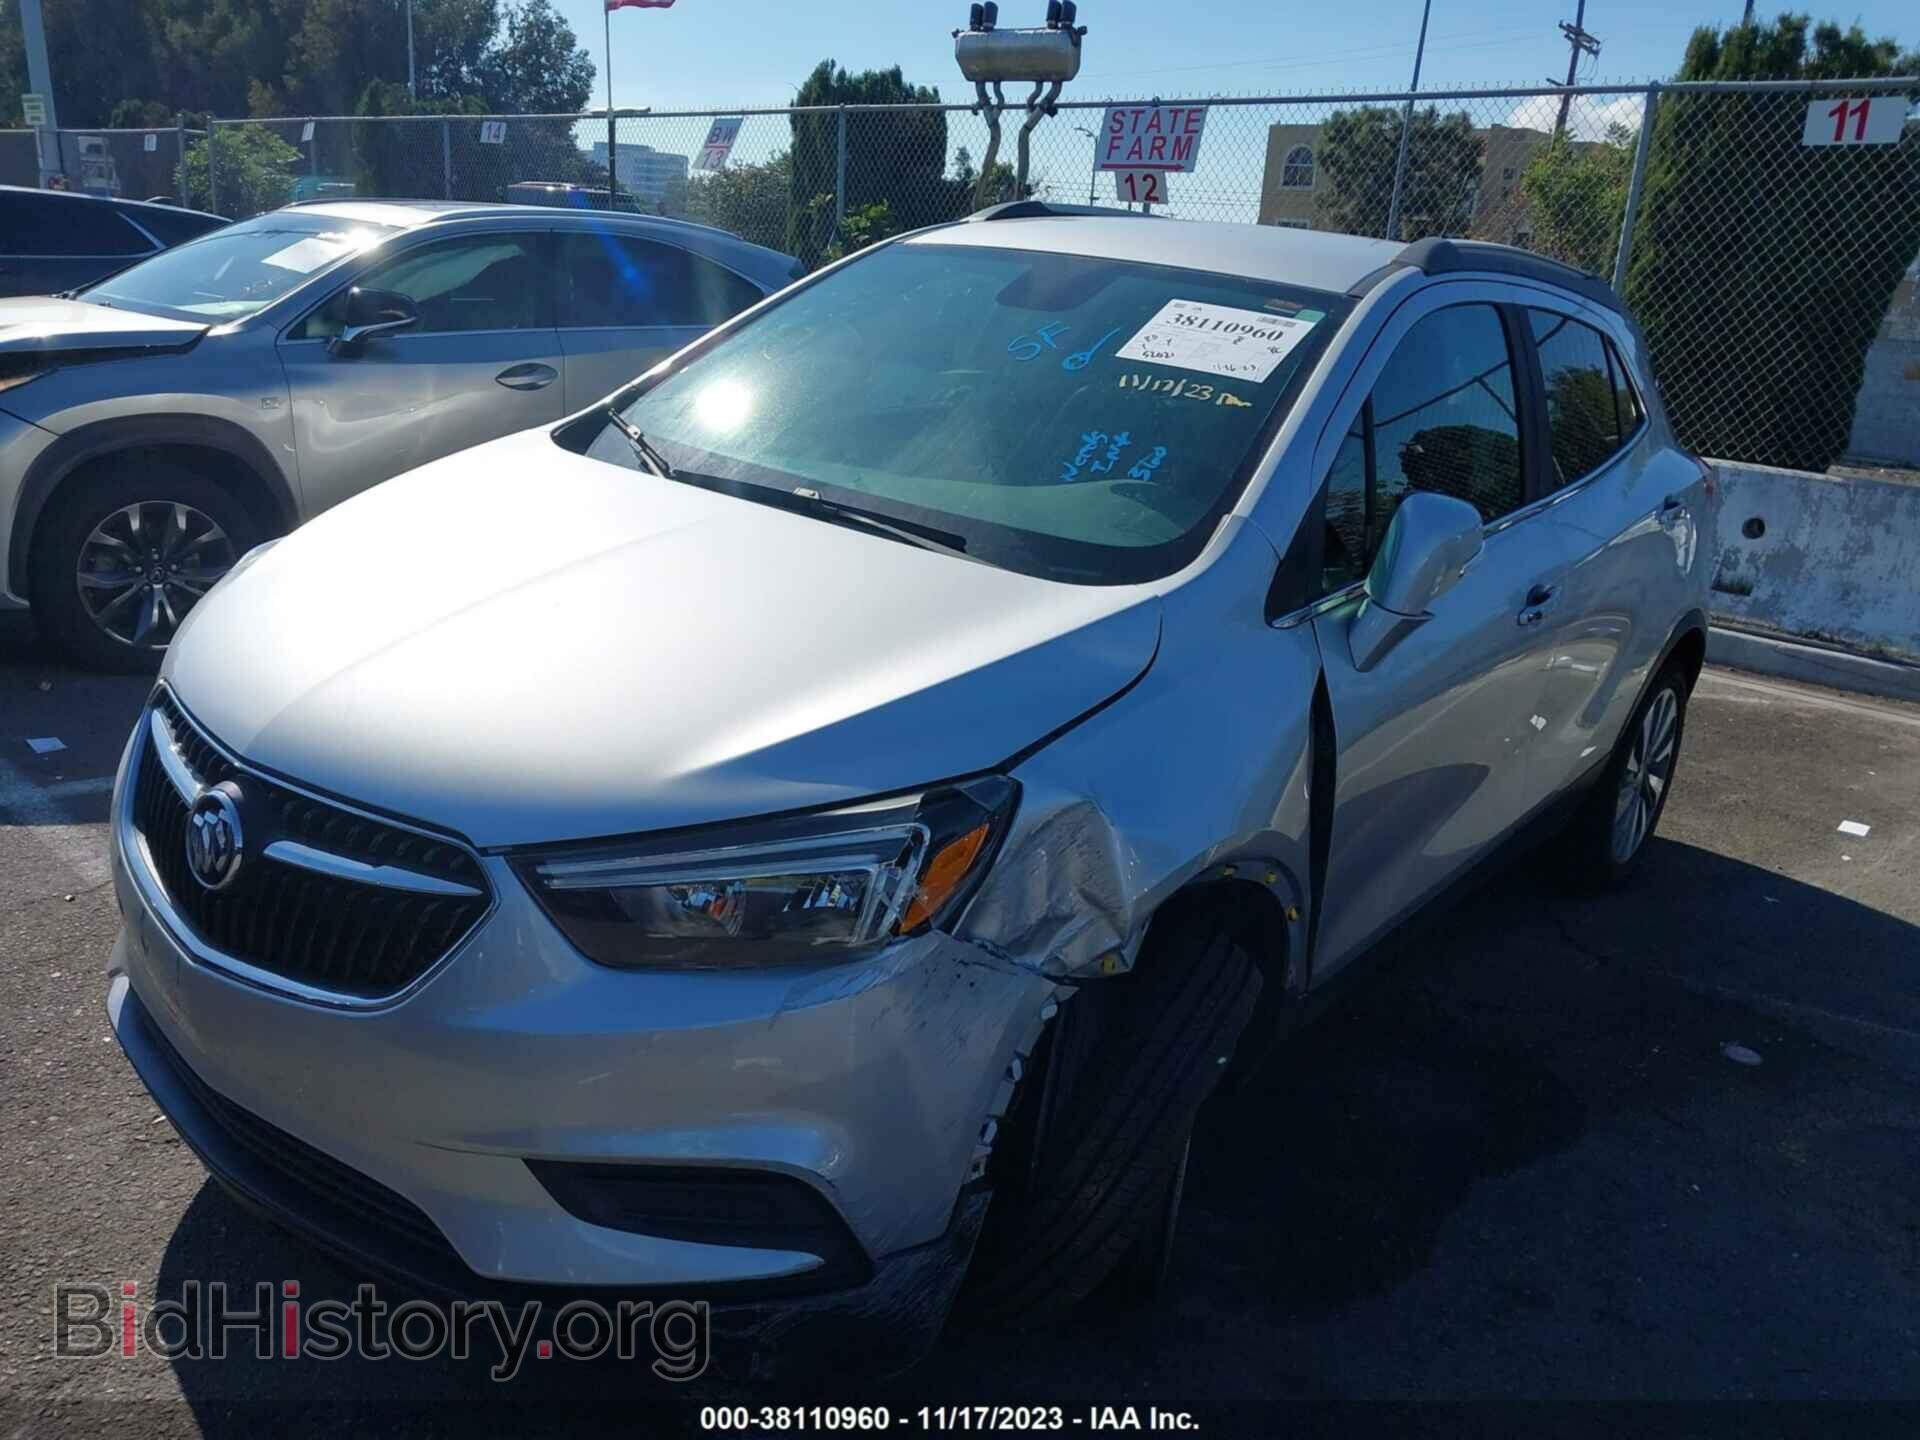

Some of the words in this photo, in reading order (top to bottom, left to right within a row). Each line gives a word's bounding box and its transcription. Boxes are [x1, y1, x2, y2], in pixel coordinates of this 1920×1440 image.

[1109, 108, 1203, 134] STATE
[1827, 98, 1871, 142] 11
[703, 150, 724, 168] 13
[1106, 135, 1194, 161] FARM
[1124, 172, 1160, 202] 12
[1166, 313, 1285, 343] 38110960
